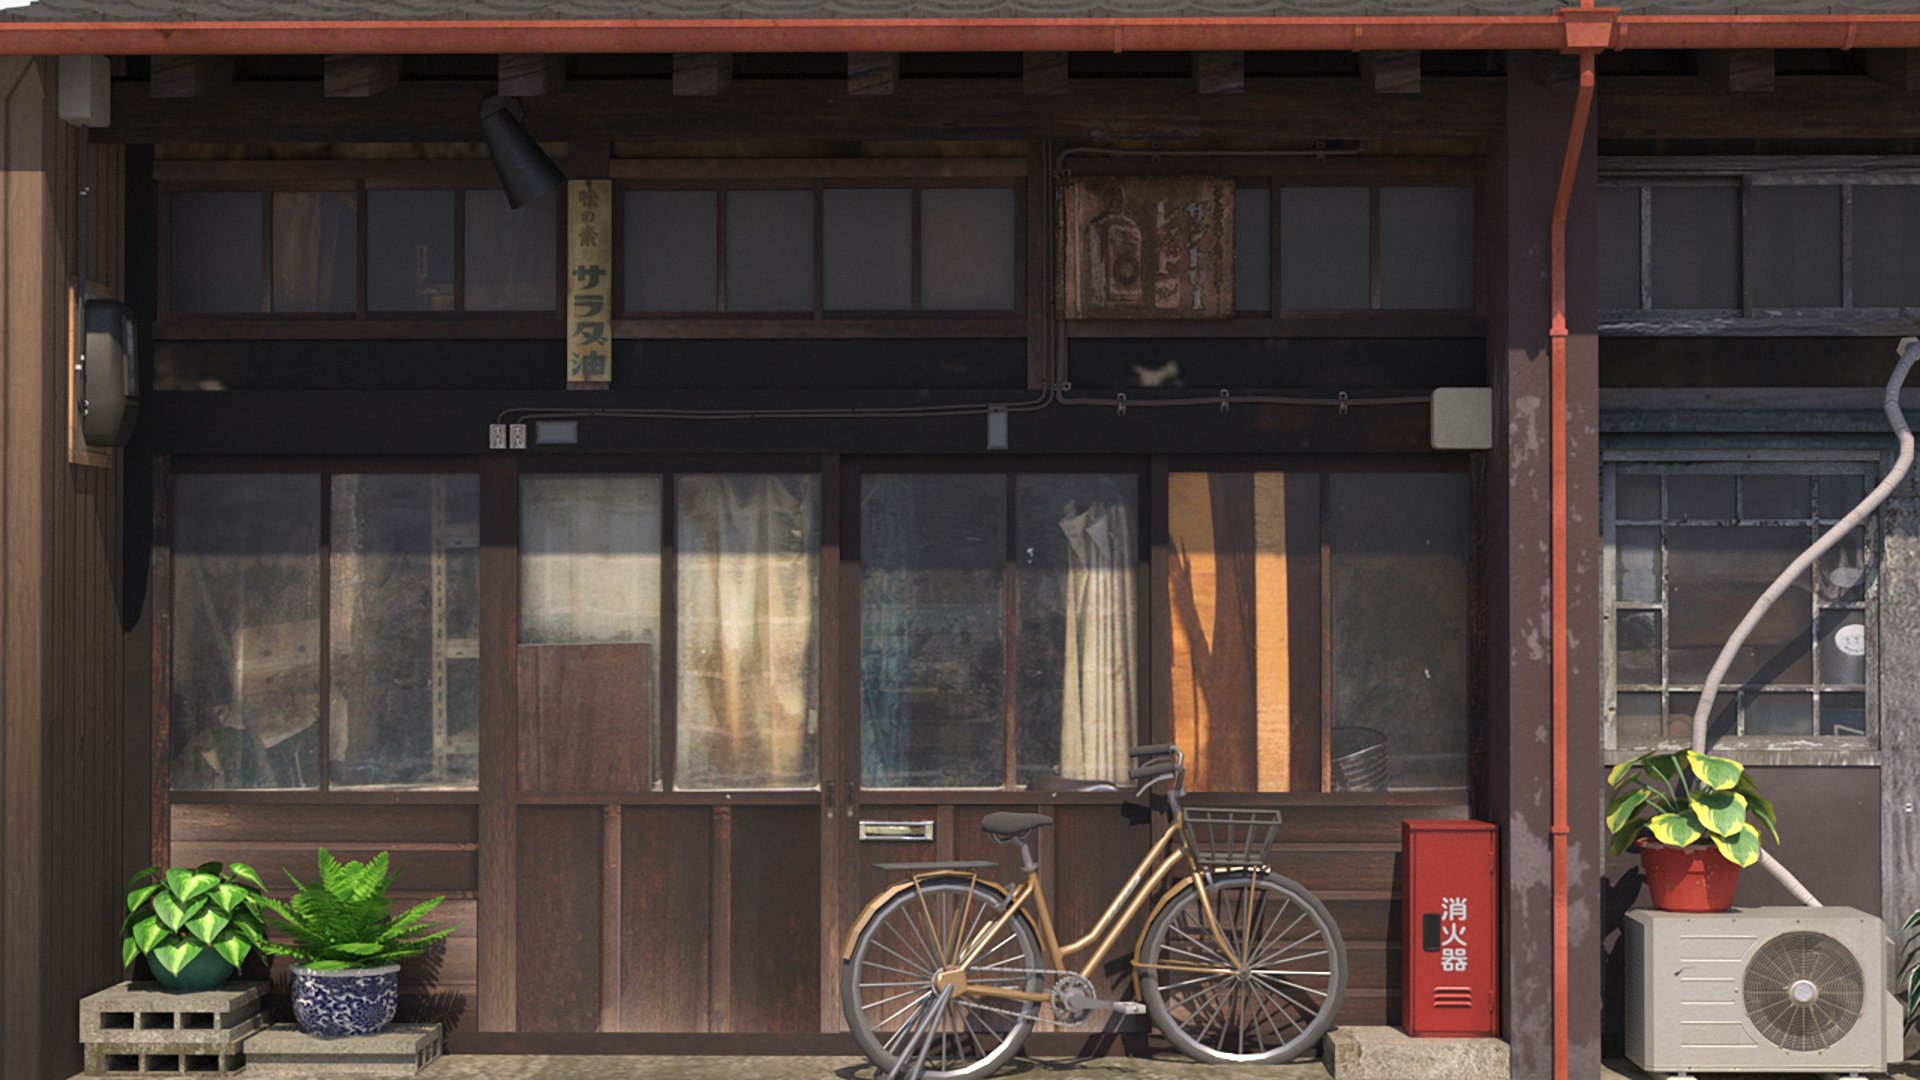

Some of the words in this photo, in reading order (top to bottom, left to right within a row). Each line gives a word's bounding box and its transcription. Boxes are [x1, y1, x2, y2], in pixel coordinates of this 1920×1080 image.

[578, 187, 599, 247] 味の素
[572, 265, 607, 376] サラダ油
[1441, 896, 1468, 972] 消火器
